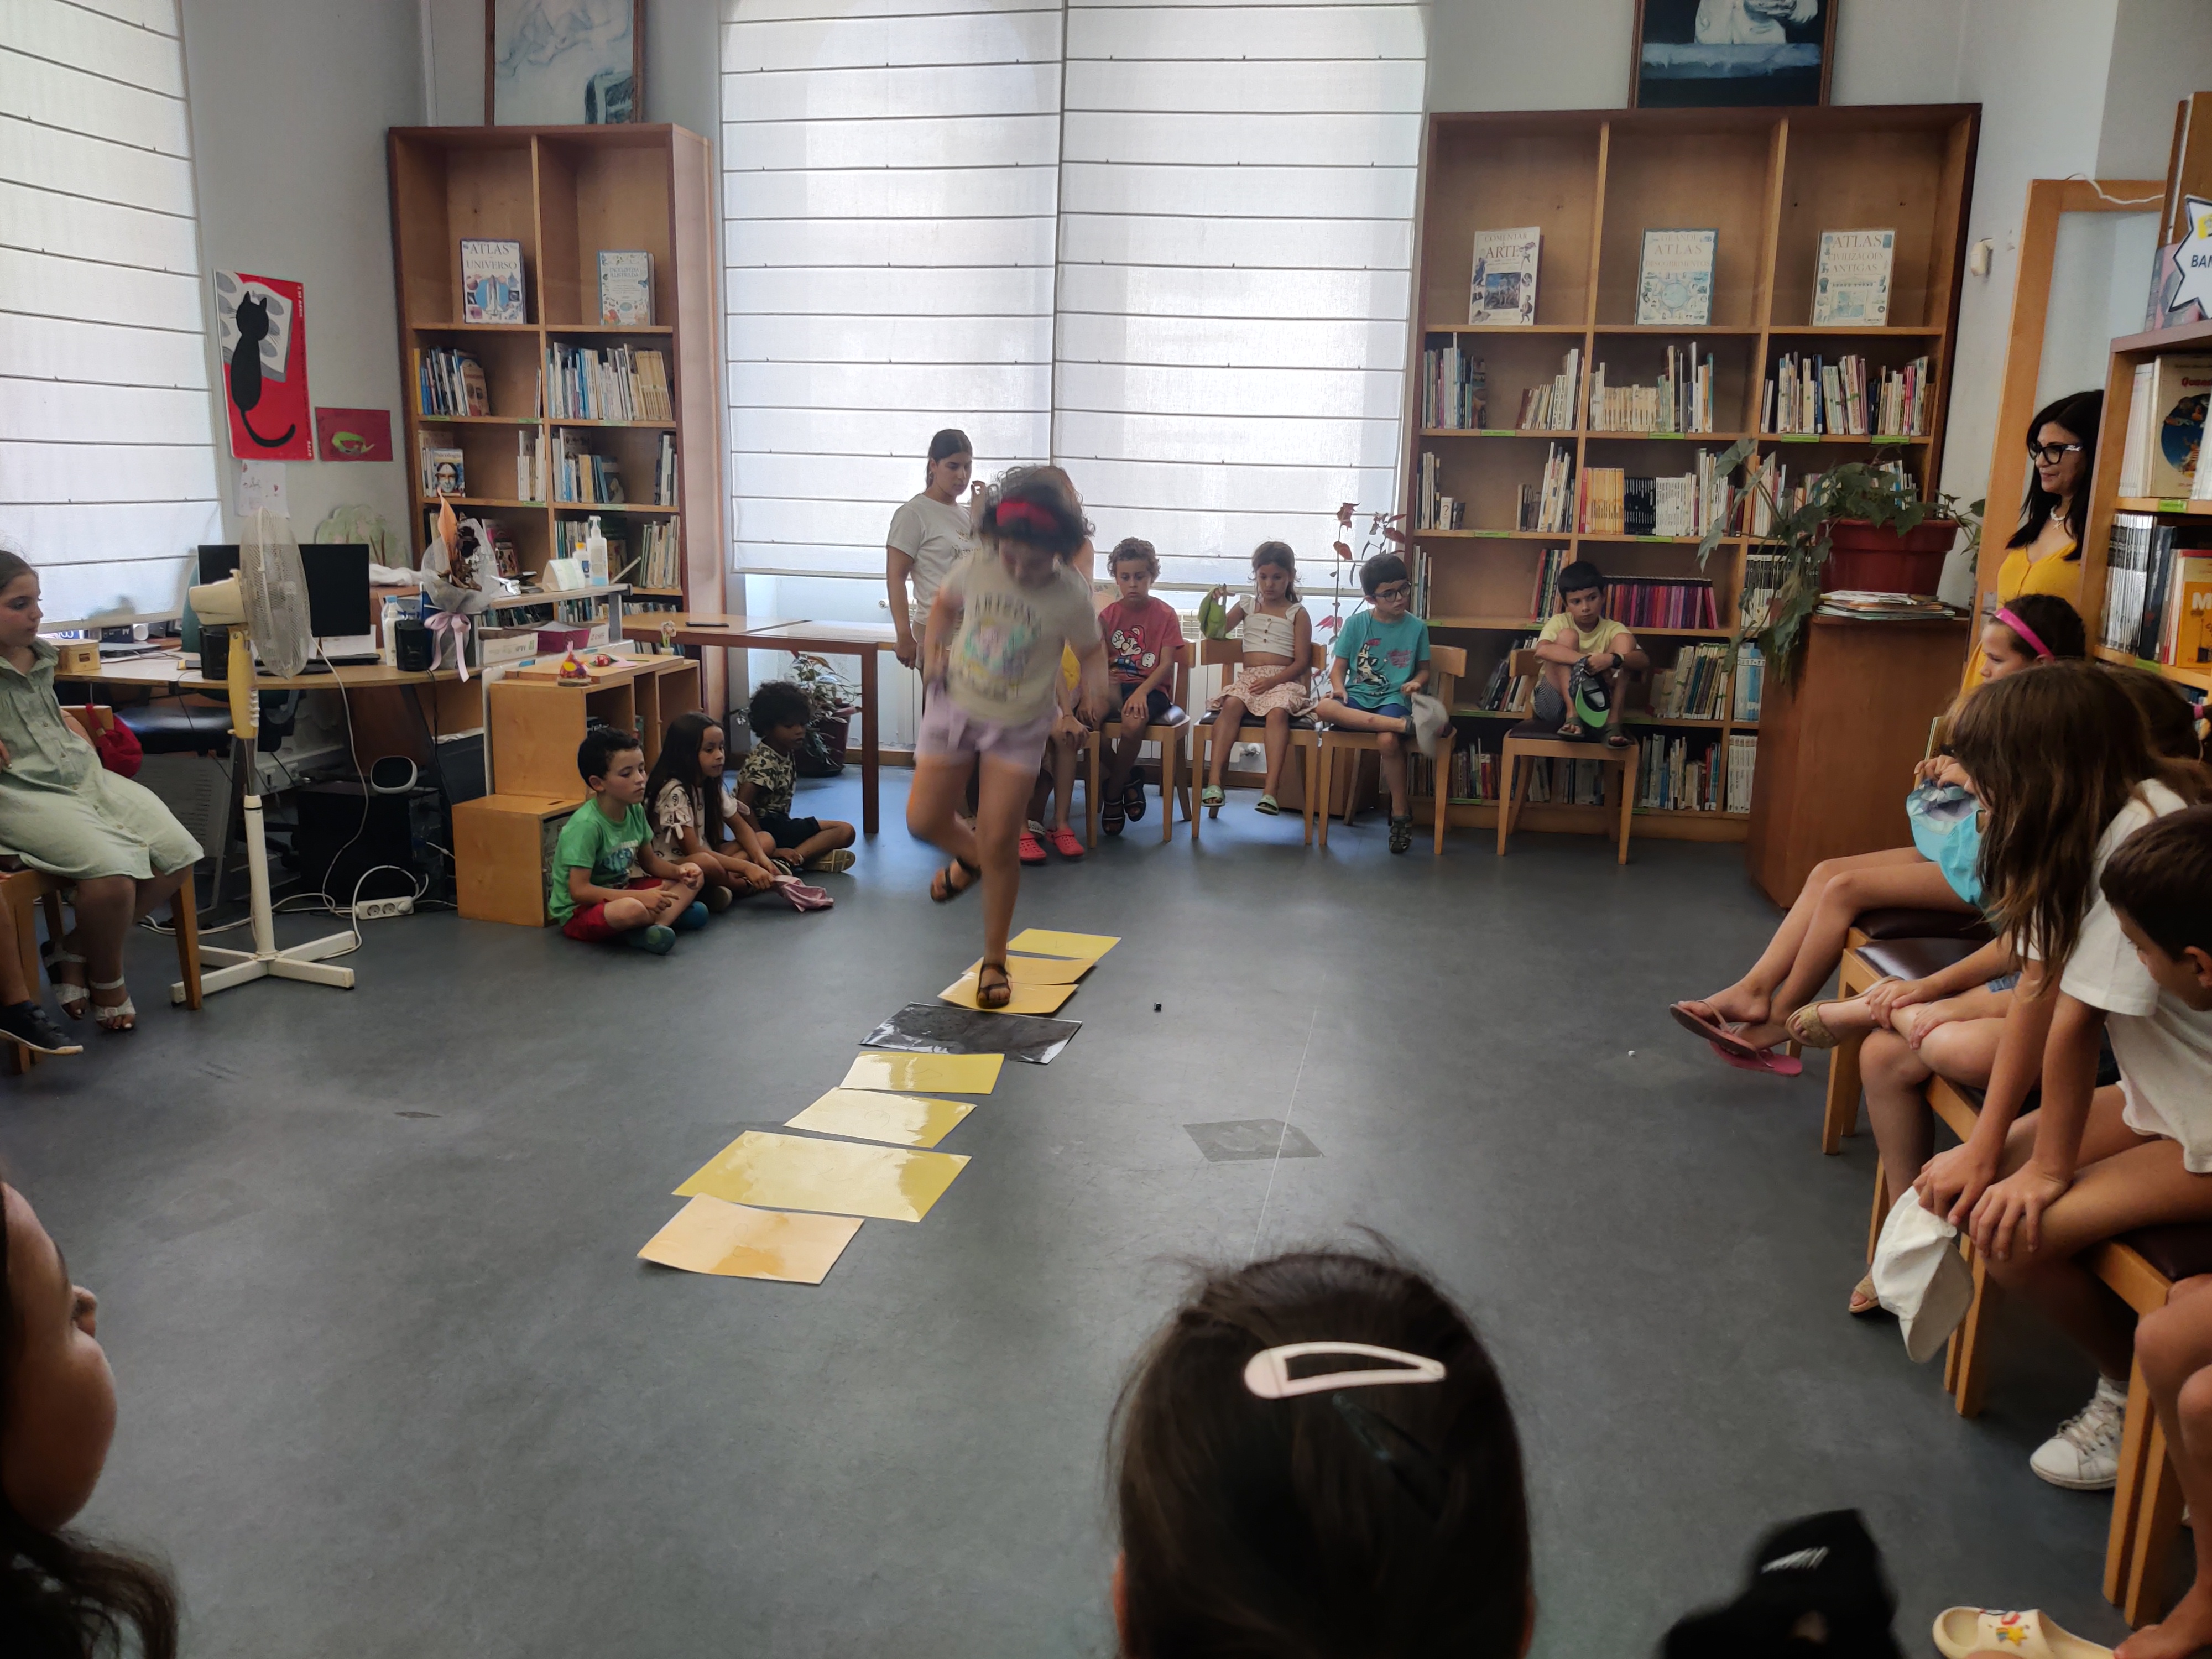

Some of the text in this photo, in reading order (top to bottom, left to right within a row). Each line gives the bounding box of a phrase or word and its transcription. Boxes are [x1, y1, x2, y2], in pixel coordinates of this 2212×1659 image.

[1485, 233, 1527, 242] COMENTAR
[1832, 234, 1882, 248] ATLAS
[471, 243, 509, 255] ATLAS
[1486, 245, 1520, 259] ARTE
[1655, 244, 1702, 255] ATLAS
[466, 260, 517, 270] UNIVERSO
[1833, 264, 1877, 272] ANTIGAS
